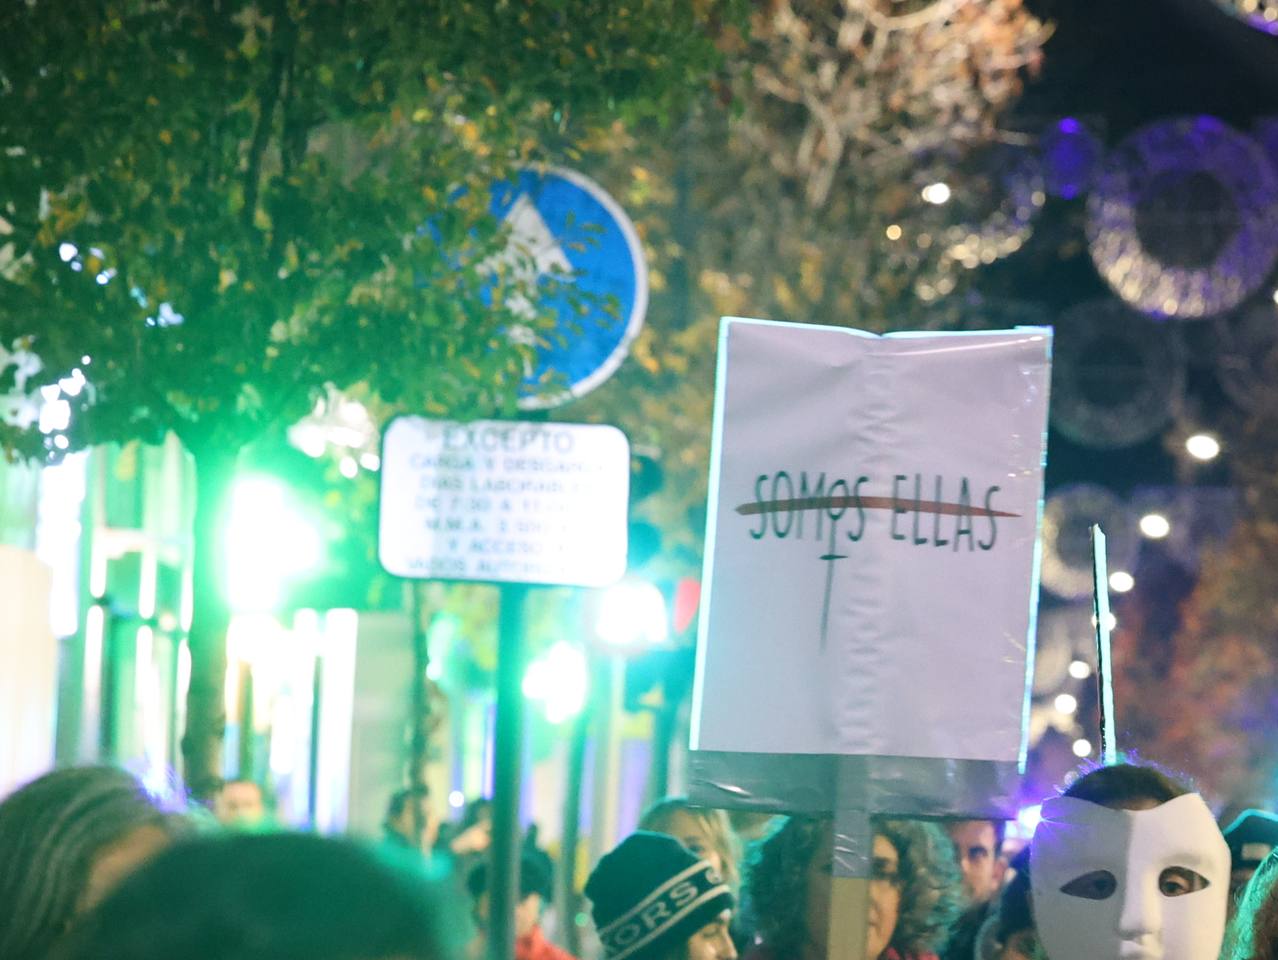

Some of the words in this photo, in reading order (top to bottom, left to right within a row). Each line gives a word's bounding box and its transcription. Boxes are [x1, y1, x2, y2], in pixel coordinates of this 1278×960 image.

[441, 424, 576, 454] EXCEPTO
[749, 470, 870, 543] SOMOS
[890, 474, 1001, 552] ELLAS
